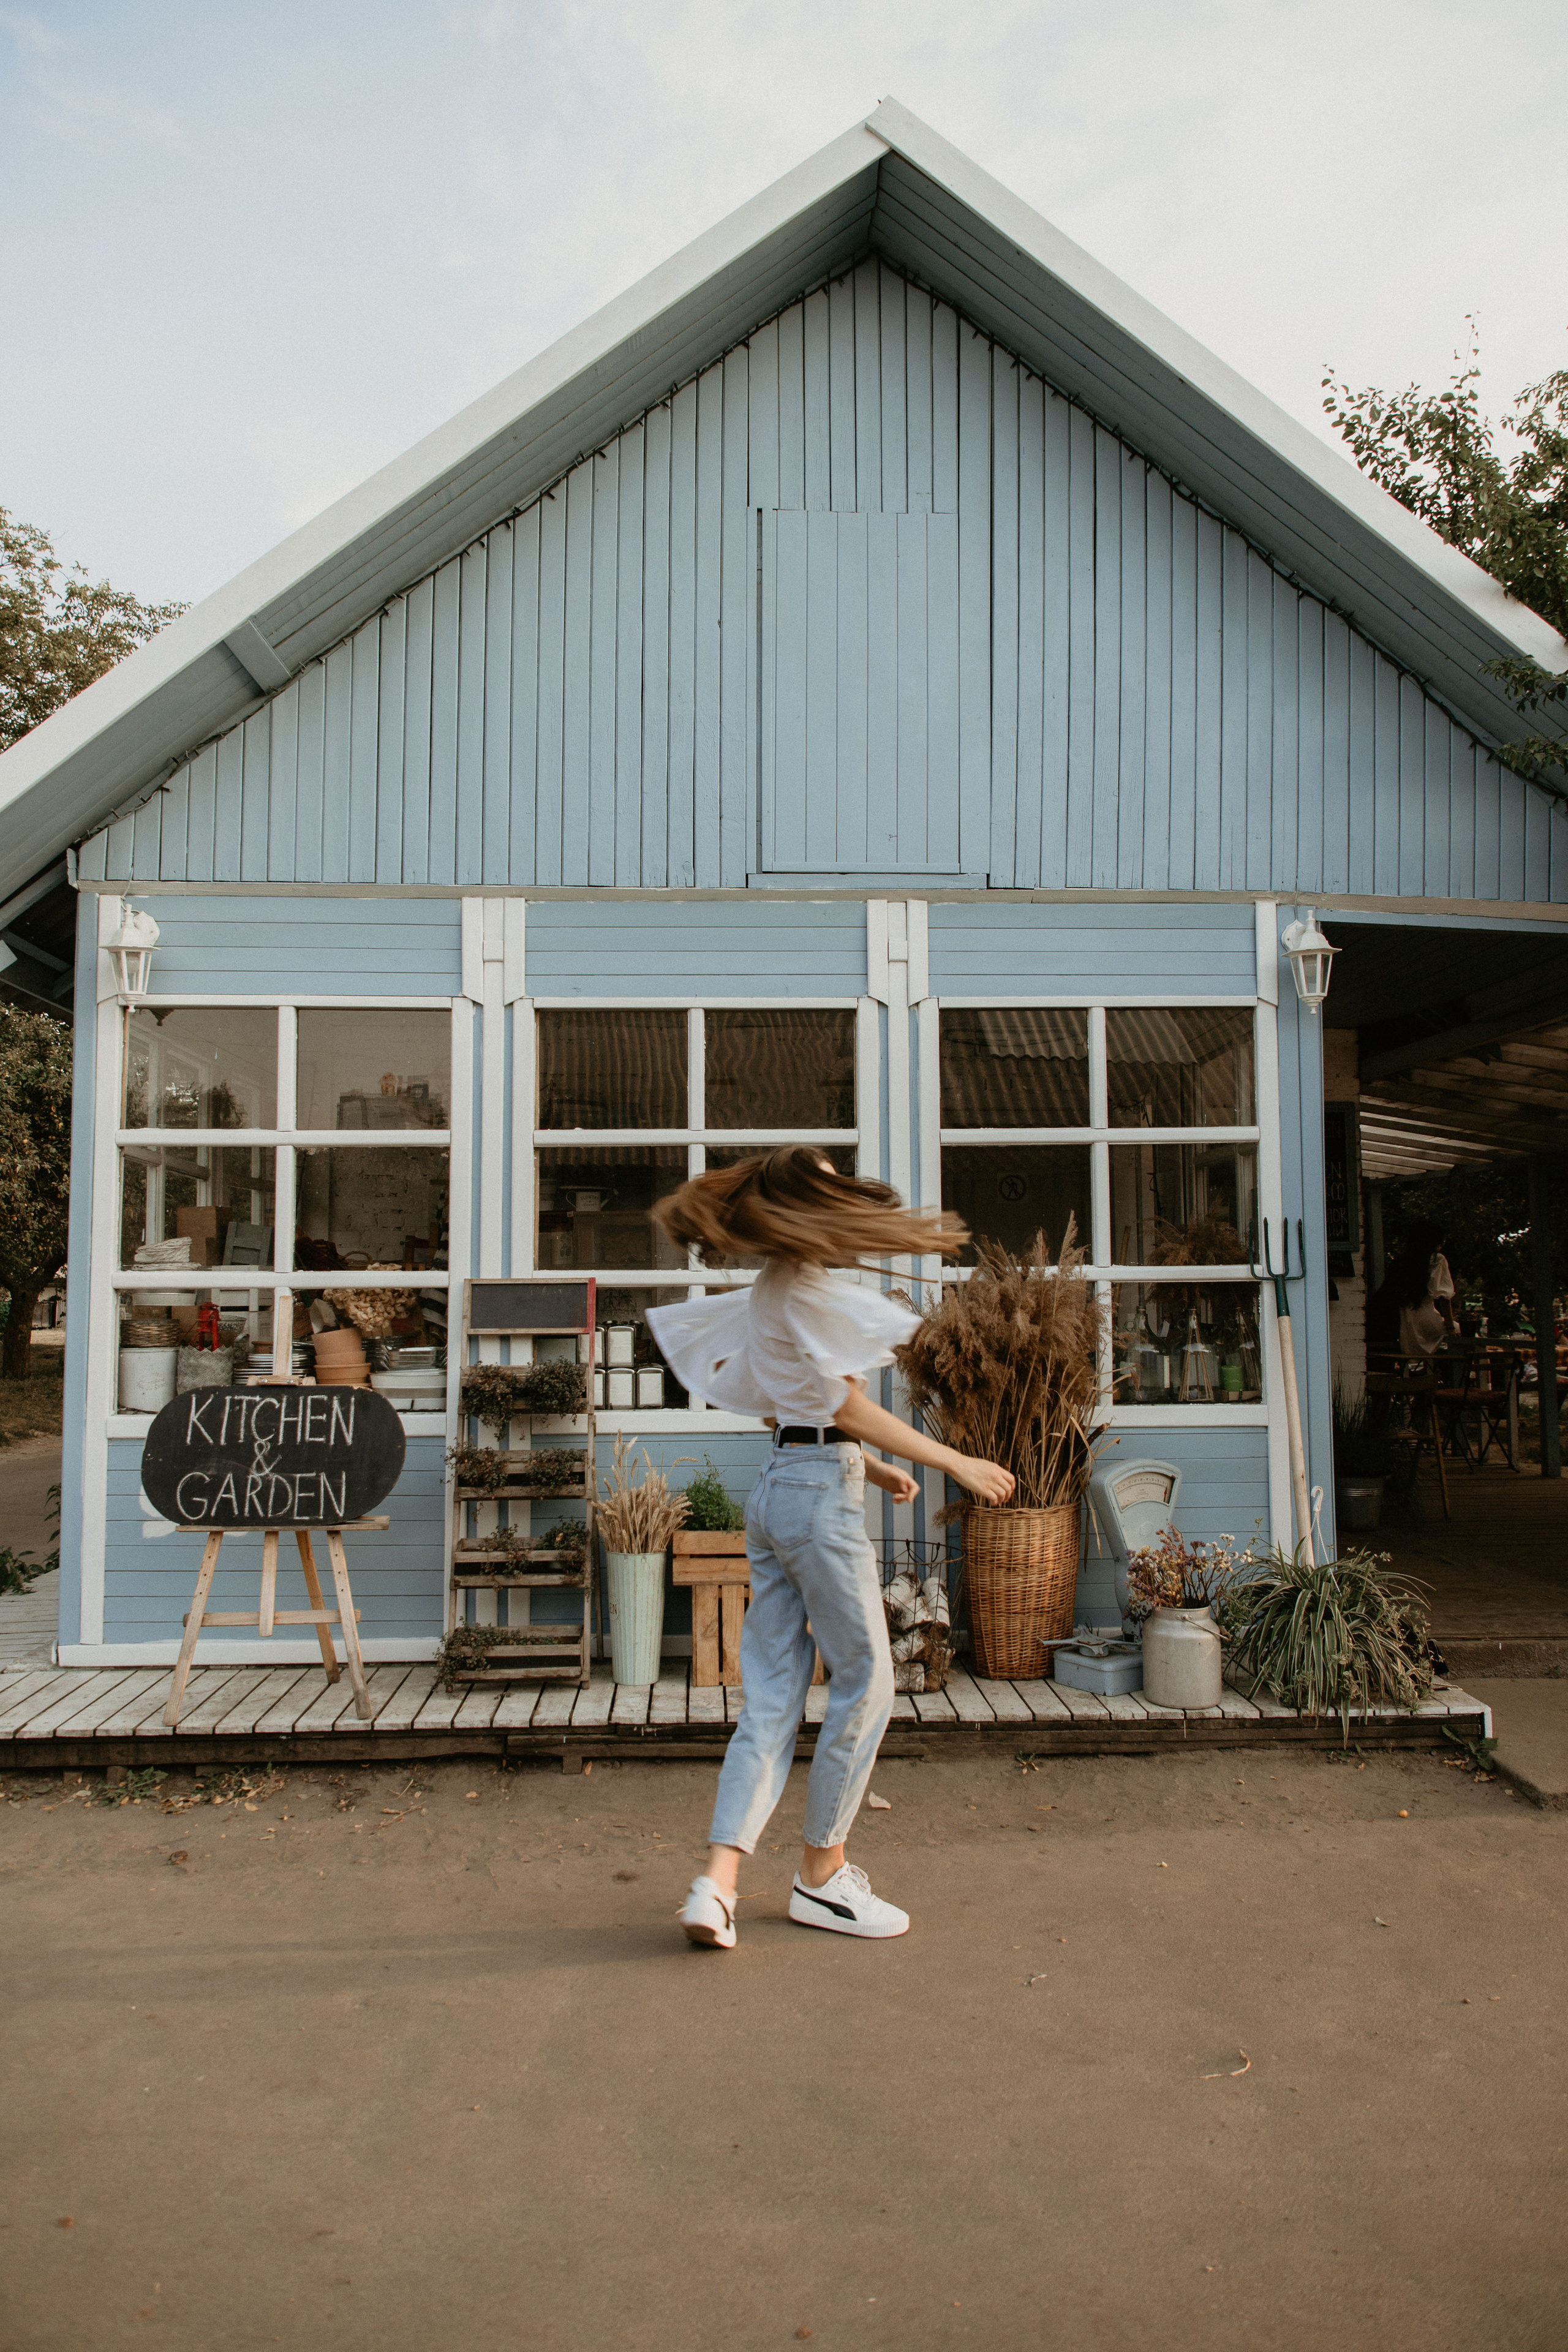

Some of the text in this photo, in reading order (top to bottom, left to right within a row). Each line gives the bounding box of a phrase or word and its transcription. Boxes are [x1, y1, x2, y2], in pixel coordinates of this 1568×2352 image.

[186, 1393, 355, 1446] KITCHEN
[251, 1439, 282, 1477] &
[176, 1471, 346, 1521] GARDEN
